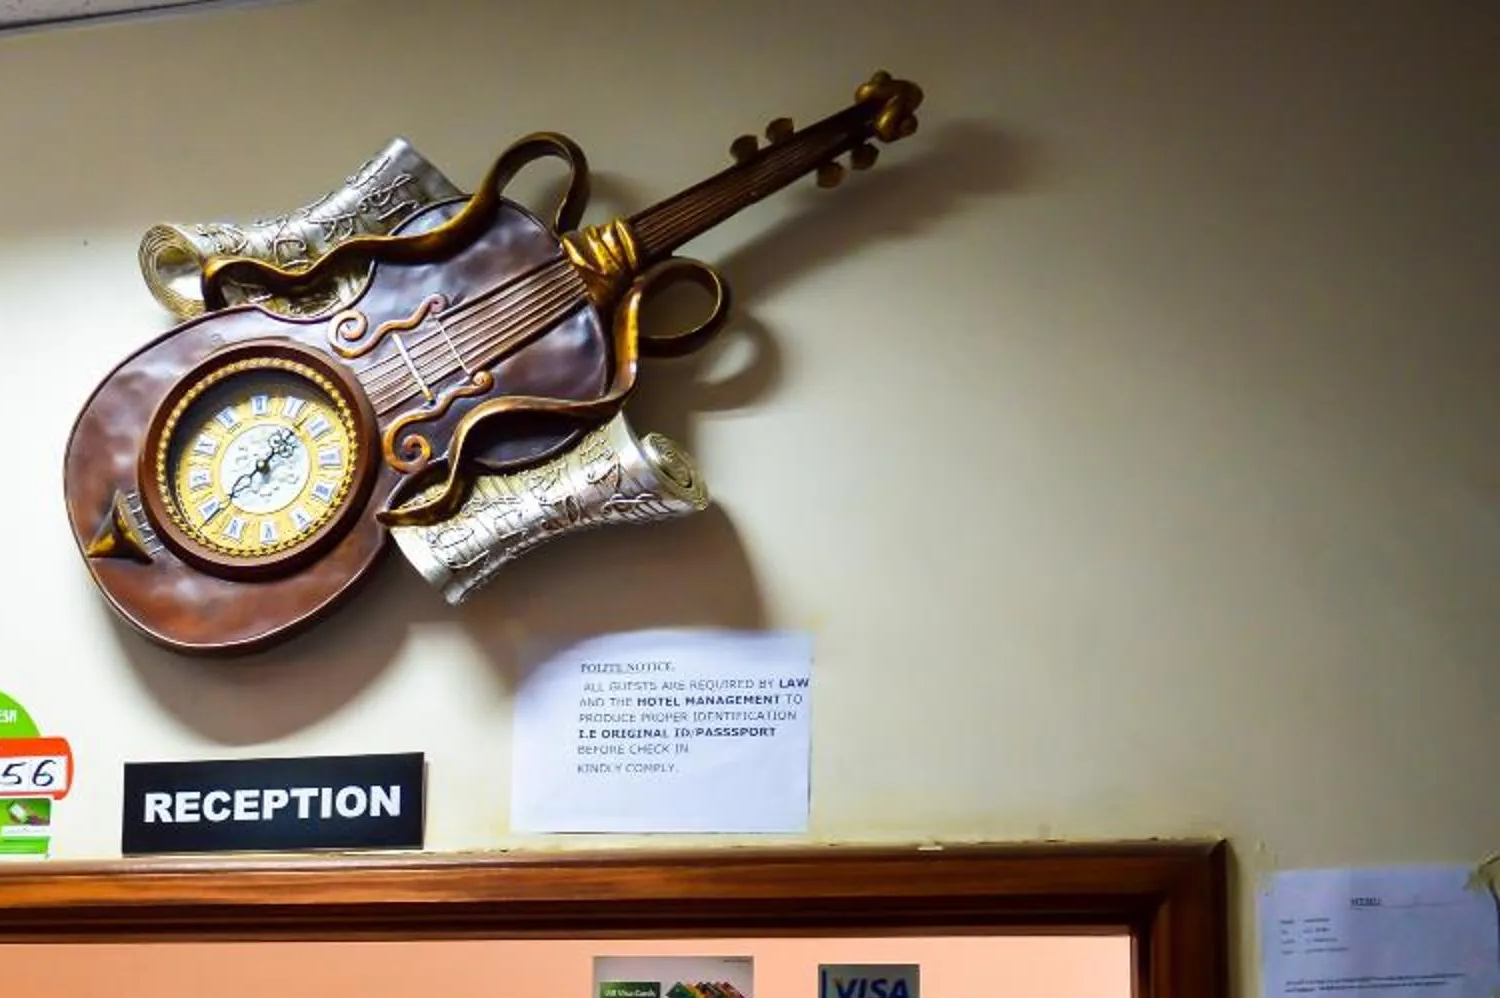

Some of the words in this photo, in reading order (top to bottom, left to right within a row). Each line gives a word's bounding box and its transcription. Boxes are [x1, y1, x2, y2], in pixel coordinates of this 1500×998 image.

[584, 682, 604, 692] ALL
[609, 681, 657, 691] GUESTS
[661, 681, 685, 691] ARE
[689, 679, 755, 691] REQUIRED
[759, 679, 774, 689] BY
[779, 678, 810, 688] LAW
[579, 697, 604, 707] AND
[609, 697, 632, 707] THE
[637, 697, 680, 707] HOTEL
[685, 695, 780, 706] MANAGEMENT
[786, 694, 803, 705] TO
[579, 713, 636, 723] PRODUCE
[641, 712, 688, 722] PROPER
[693, 711, 797, 721] IDENTIFICATION
[601, 729, 669, 739] ORIGINAL
[577, 744, 625, 755] BEFORE
[629, 743, 669, 755] CHECK
[675, 743, 689, 754] IN
[577, 763, 623, 773] KINDLY
[143, 785, 402, 823] RECEPTION
